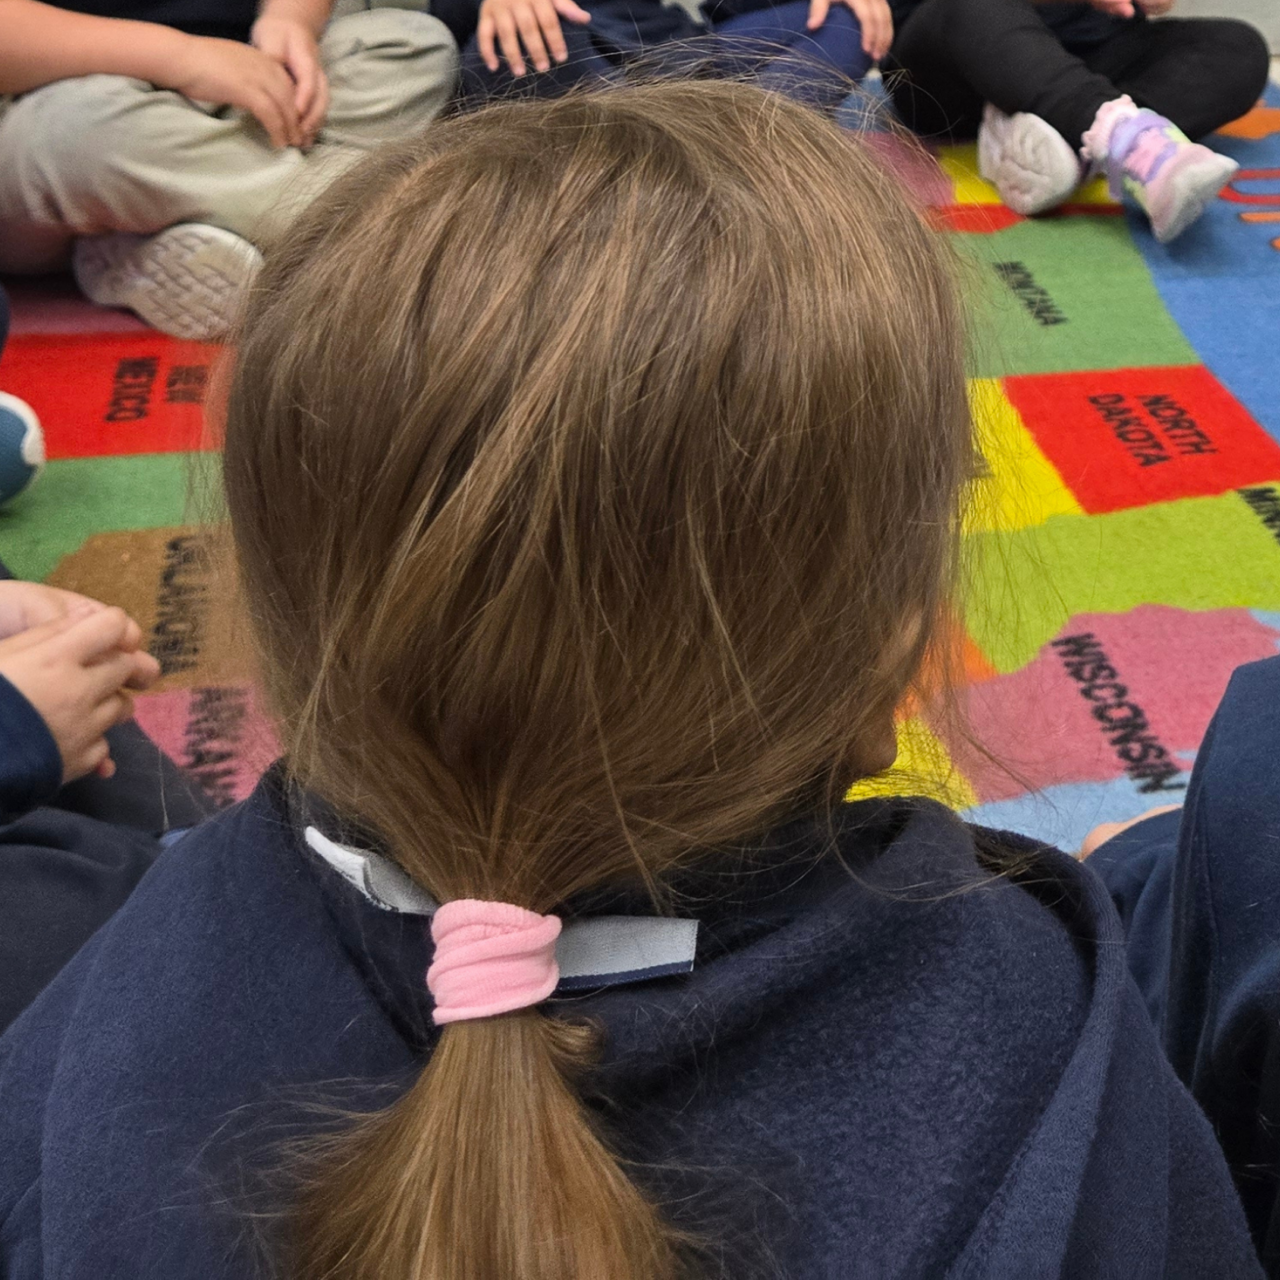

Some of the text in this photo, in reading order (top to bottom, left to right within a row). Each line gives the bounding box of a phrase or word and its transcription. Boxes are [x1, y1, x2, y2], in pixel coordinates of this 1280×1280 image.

[1087, 393, 1171, 468] DAKOTA
[1136, 394, 1218, 456] NORTH
[1051, 633, 1187, 795] WISCONSIN
